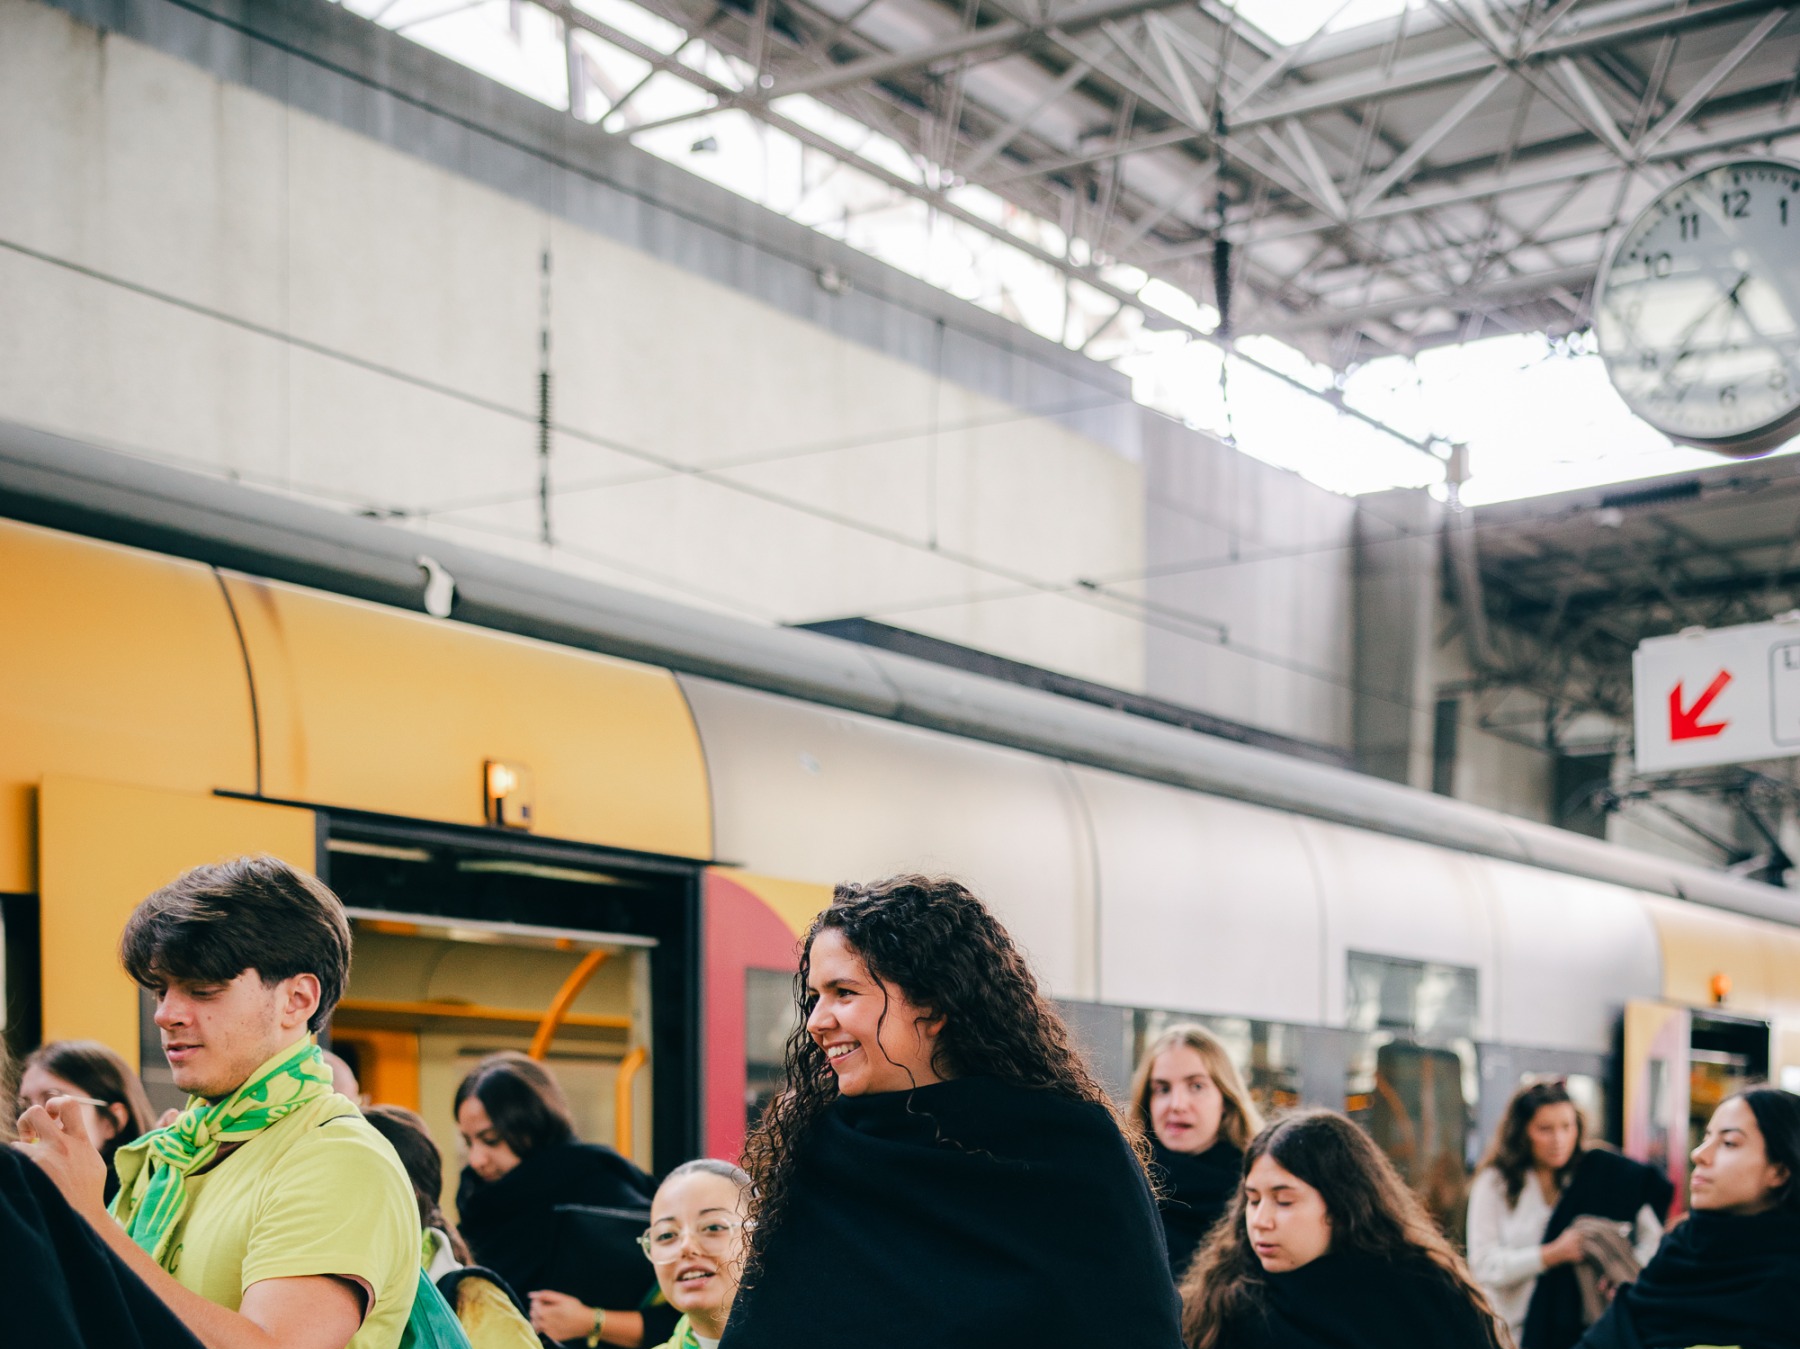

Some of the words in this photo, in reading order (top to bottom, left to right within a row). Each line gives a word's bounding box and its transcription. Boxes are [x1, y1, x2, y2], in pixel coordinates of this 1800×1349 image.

[1721, 189, 1751, 219] 12
[1779, 197, 1788, 227] 1
[1680, 213, 1699, 241] 11
